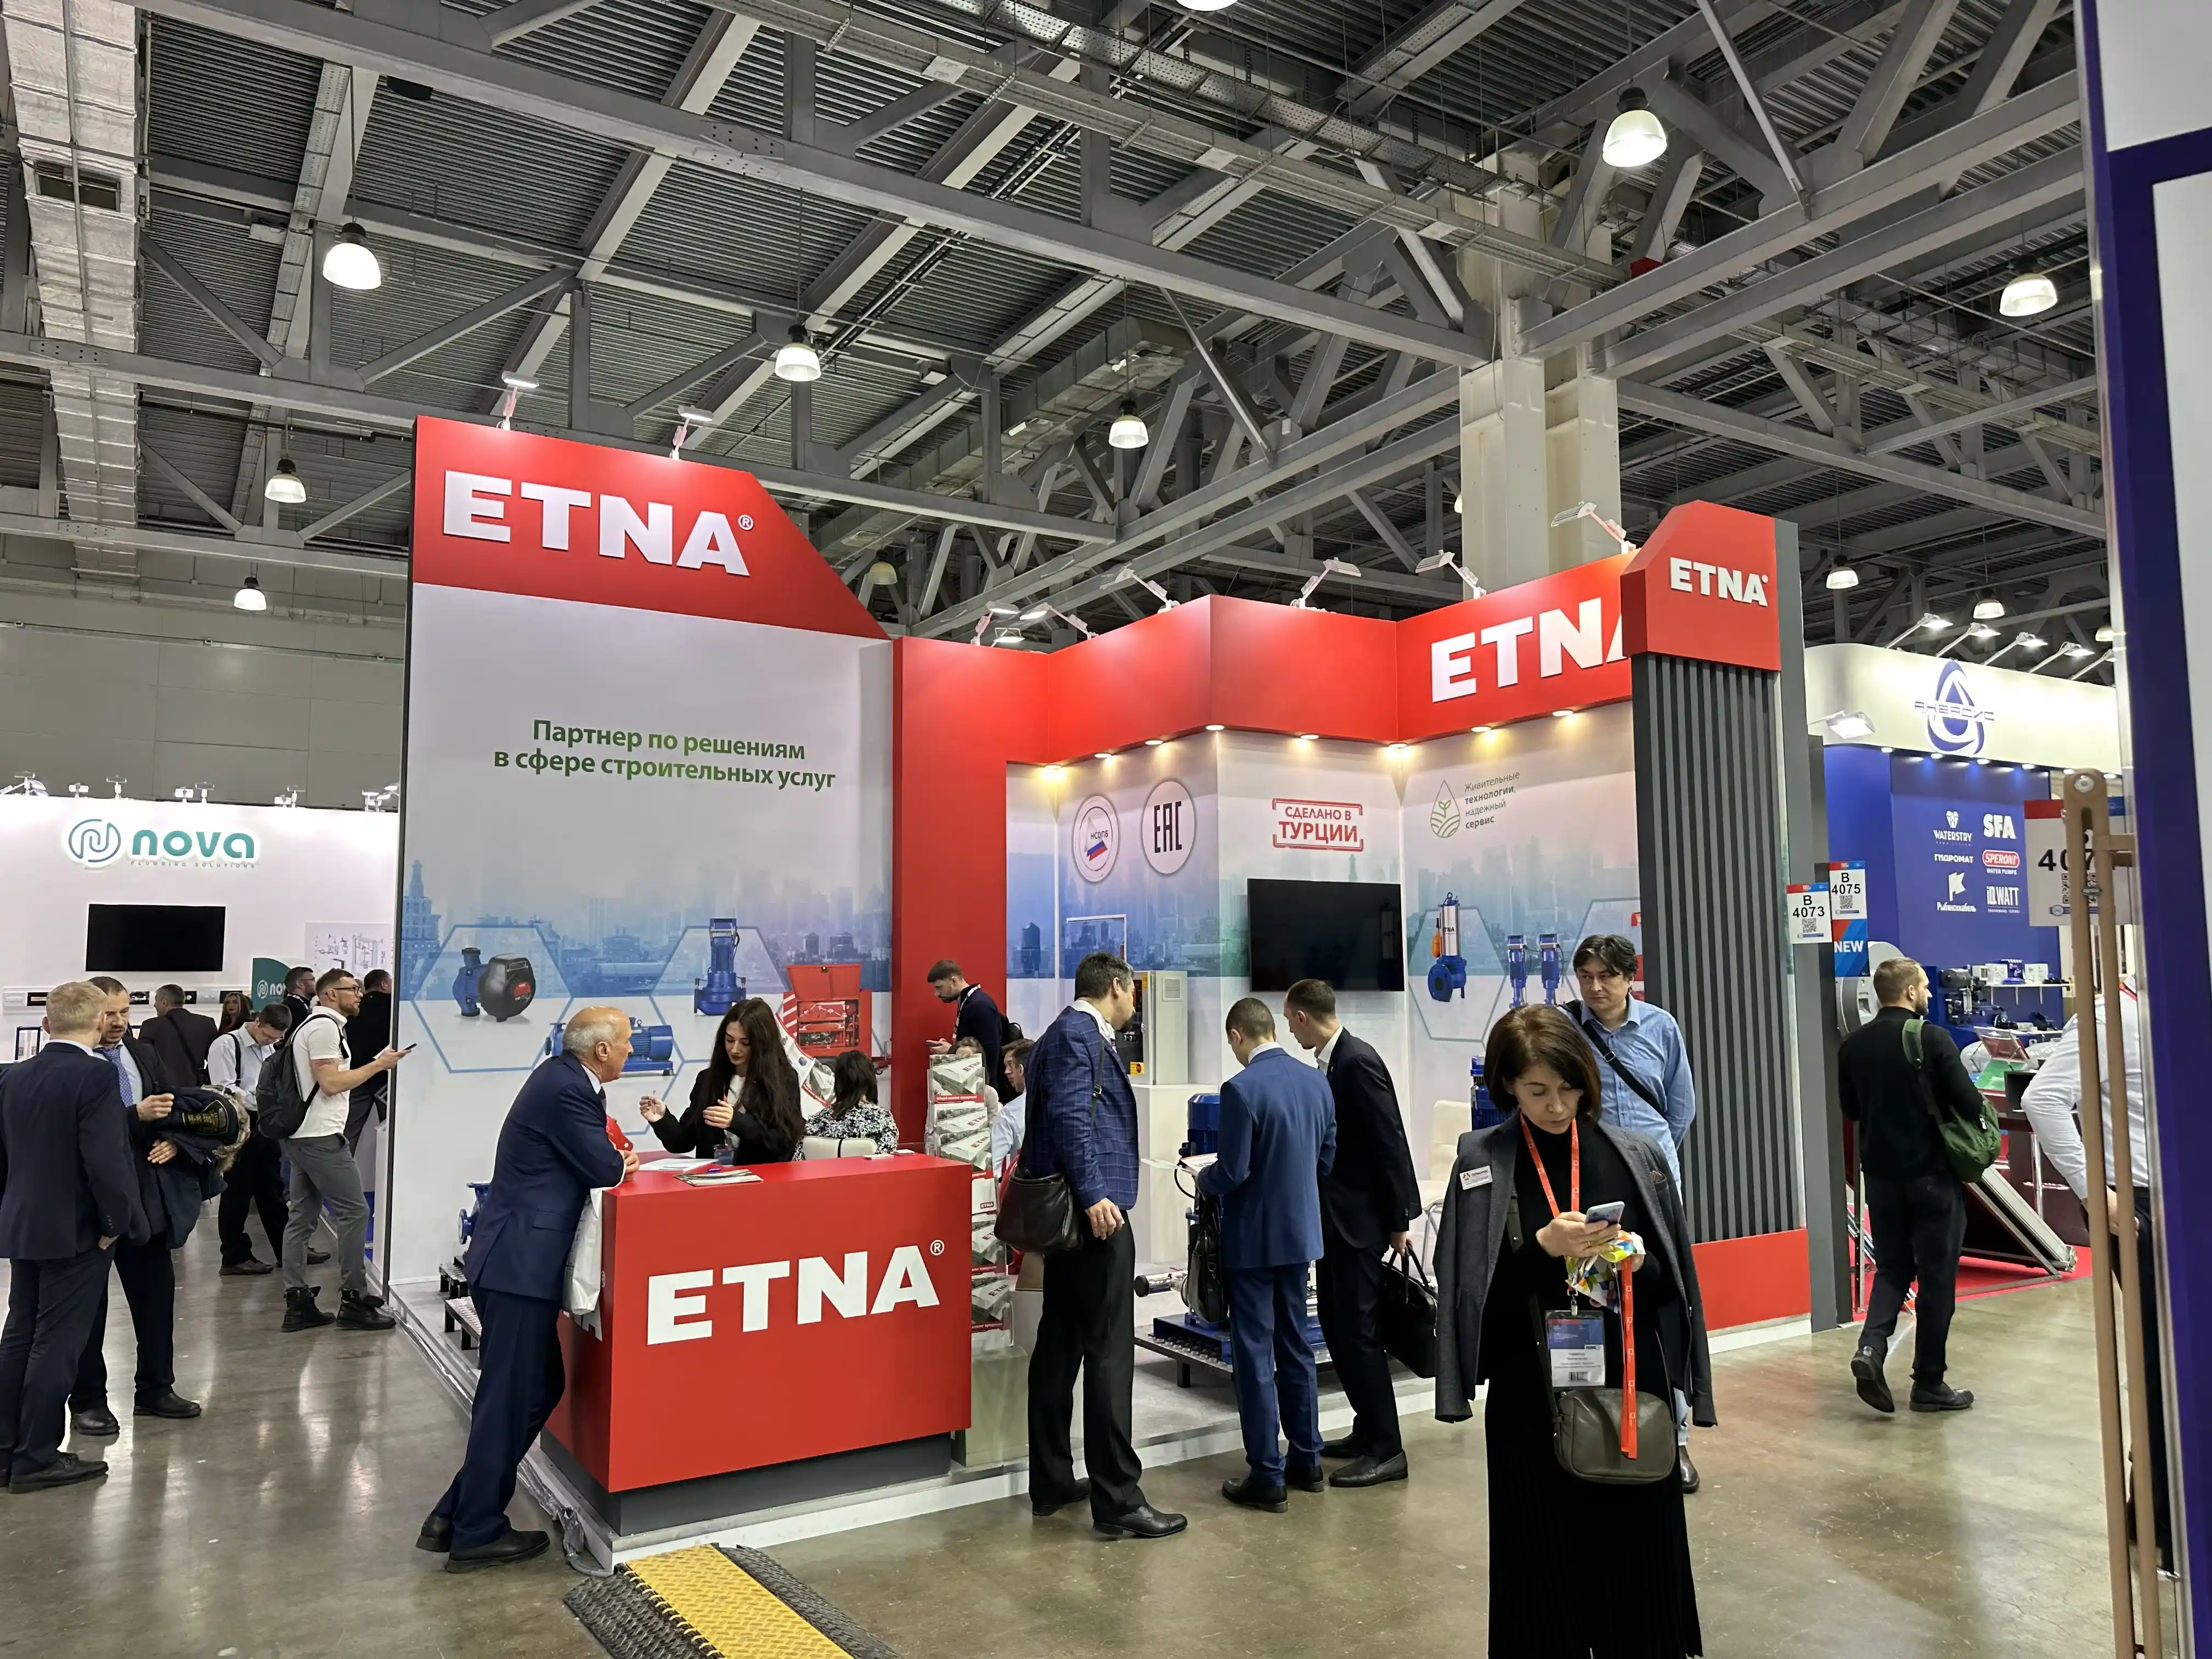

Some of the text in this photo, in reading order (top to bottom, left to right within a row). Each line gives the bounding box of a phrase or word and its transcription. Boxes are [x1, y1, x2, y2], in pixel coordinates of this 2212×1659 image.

[533, 719, 805, 759] Партнер по решениям
[494, 748, 836, 792] в сфере строительных услуг
[1464, 772, 1520, 793] Живительные
[1285, 806, 1351, 821] СДЕЛАНО В
[1465, 799, 1506, 816] надежный
[1465, 816, 1494, 829] сервис
[1983, 814, 2017, 839] SFA
[1091, 830, 1109, 840] НСОПБ
[1279, 821, 1357, 844] ТУРЦИИ
[1933, 830, 1972, 842] WATERSTRY
[132, 830, 255, 859] nova
[1984, 853, 2018, 866] SPERONI
[1841, 872, 1849, 883] B
[1832, 884, 1861, 895] 4075
[1803, 895, 1813, 906] B
[1793, 906, 1825, 918] 4073
[1833, 940, 1864, 953] NEW
